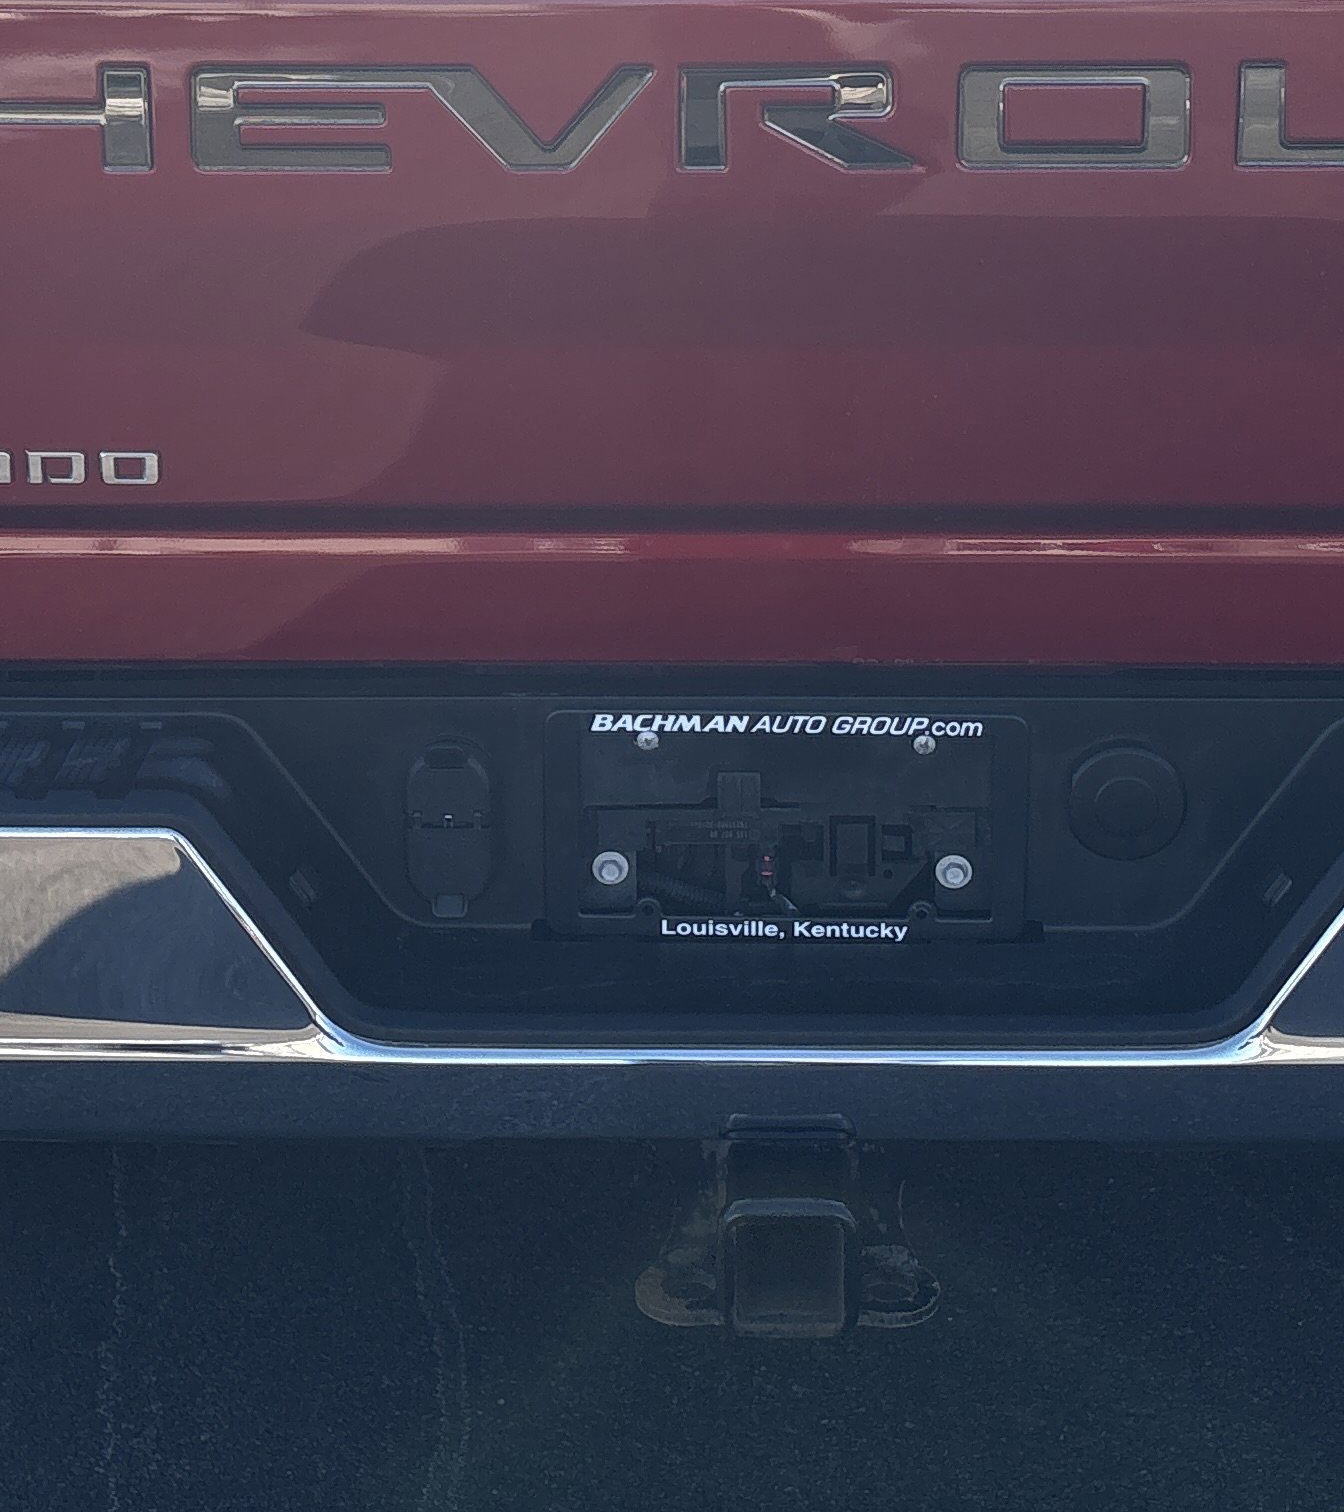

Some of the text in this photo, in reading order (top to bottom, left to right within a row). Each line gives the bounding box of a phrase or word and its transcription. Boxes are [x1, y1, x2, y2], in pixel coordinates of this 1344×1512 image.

[590, 713, 984, 737] BACHMAN AUTO GROUP.com
[660, 919, 909, 942] Louisville, Kentucky
